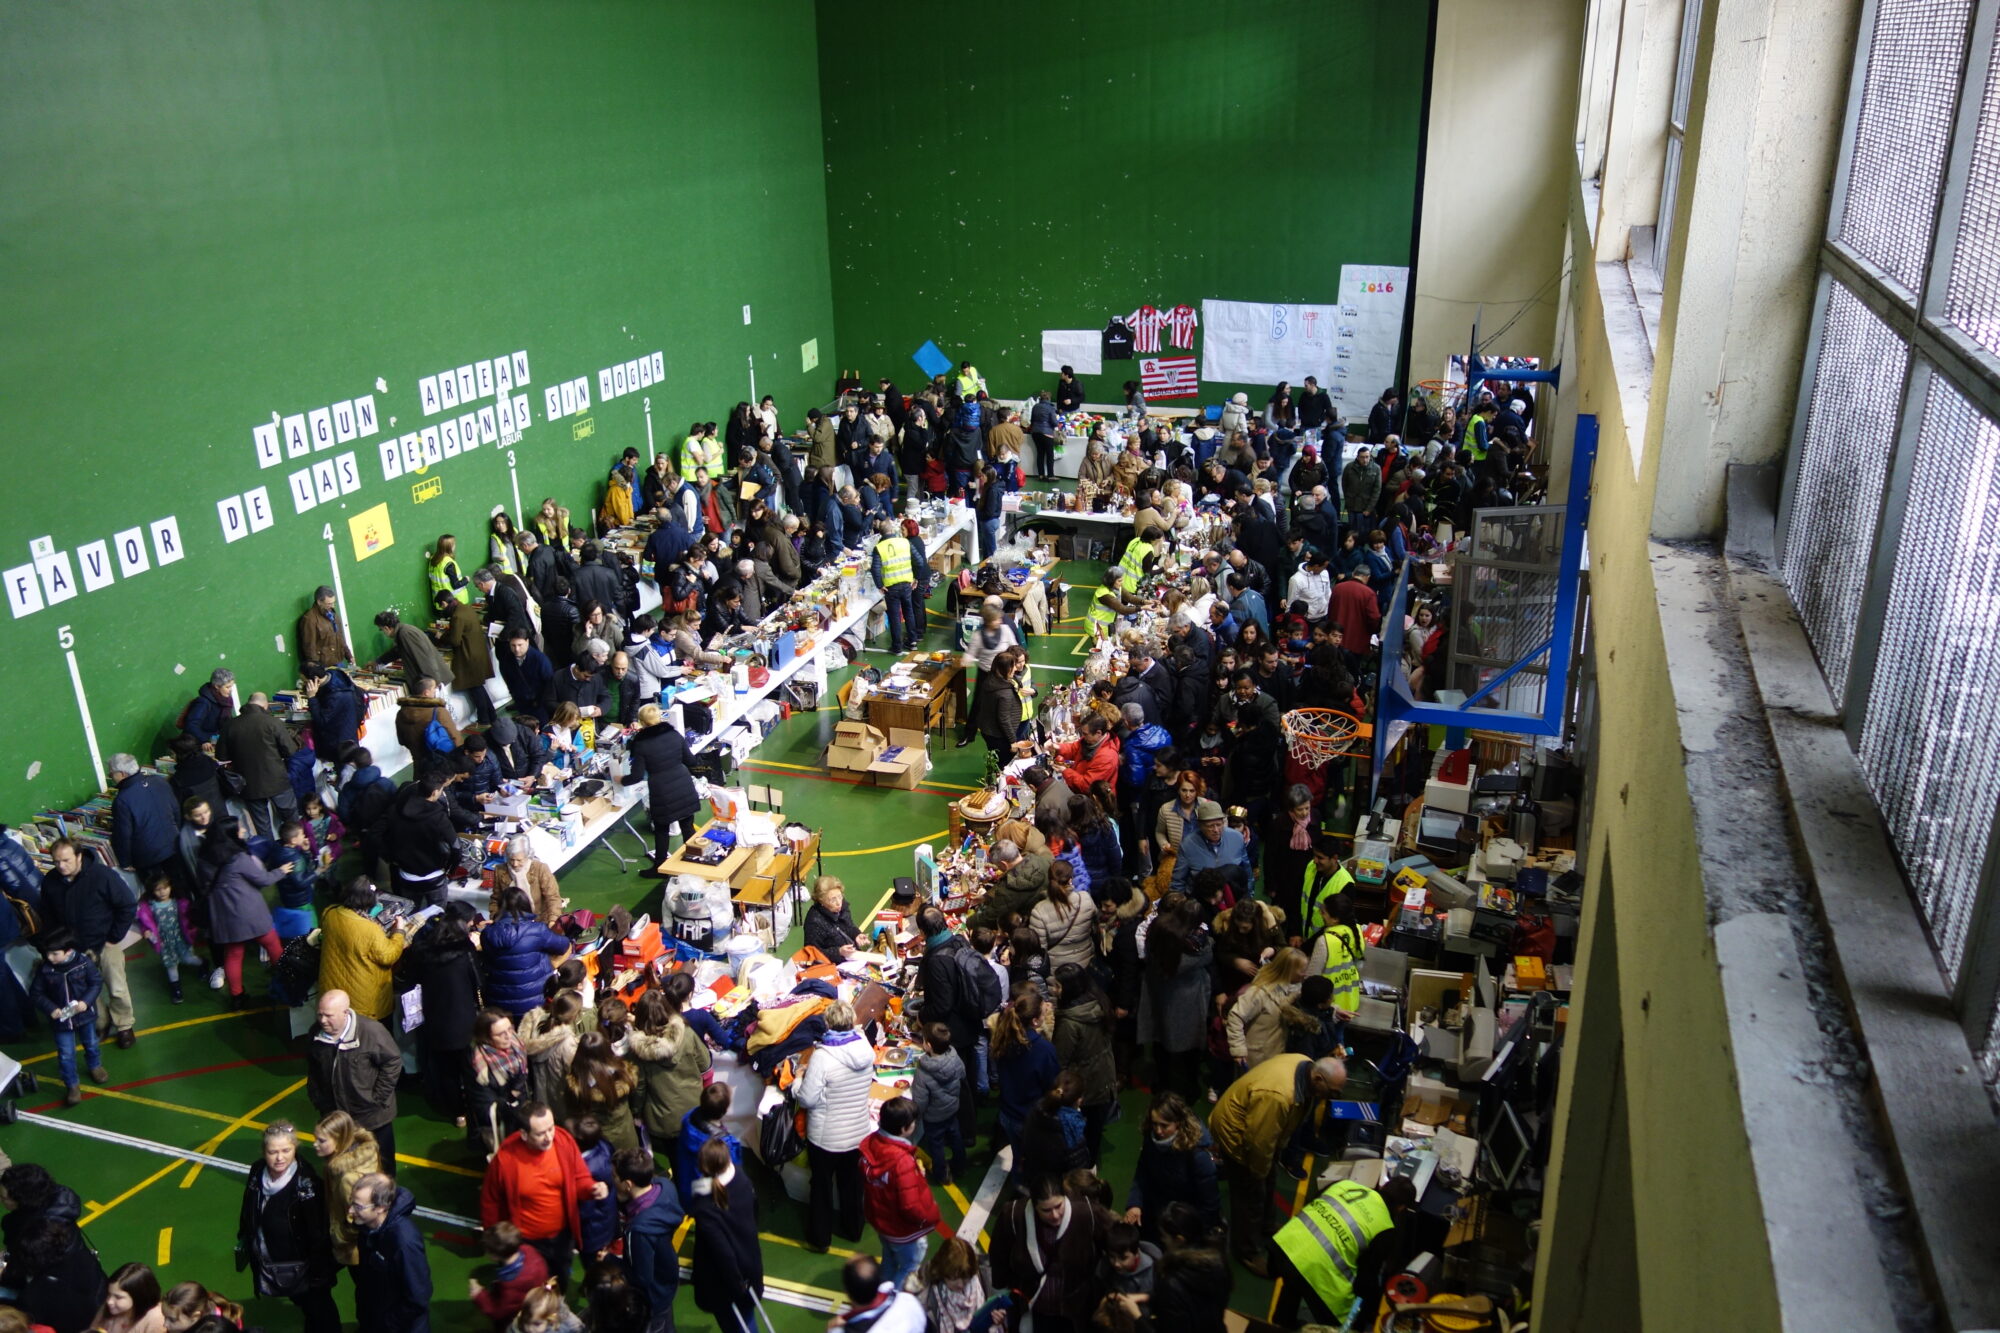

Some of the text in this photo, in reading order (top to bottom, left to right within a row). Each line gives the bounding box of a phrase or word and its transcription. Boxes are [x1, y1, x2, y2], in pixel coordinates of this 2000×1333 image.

[1359, 280, 1394, 294] 2016
[1271, 303, 1319, 340] B T
[262, 357, 527, 458] LAGUN ARTEAN
[643, 397, 651, 413] 2
[496, 430, 523, 450] LABUR
[507, 449, 516, 468] 3
[16, 358, 663, 605] FAVOR DE LAS PERSONAS SIN HOGAR
[322, 522, 334, 542] 4
[57, 624, 75, 650] 5
